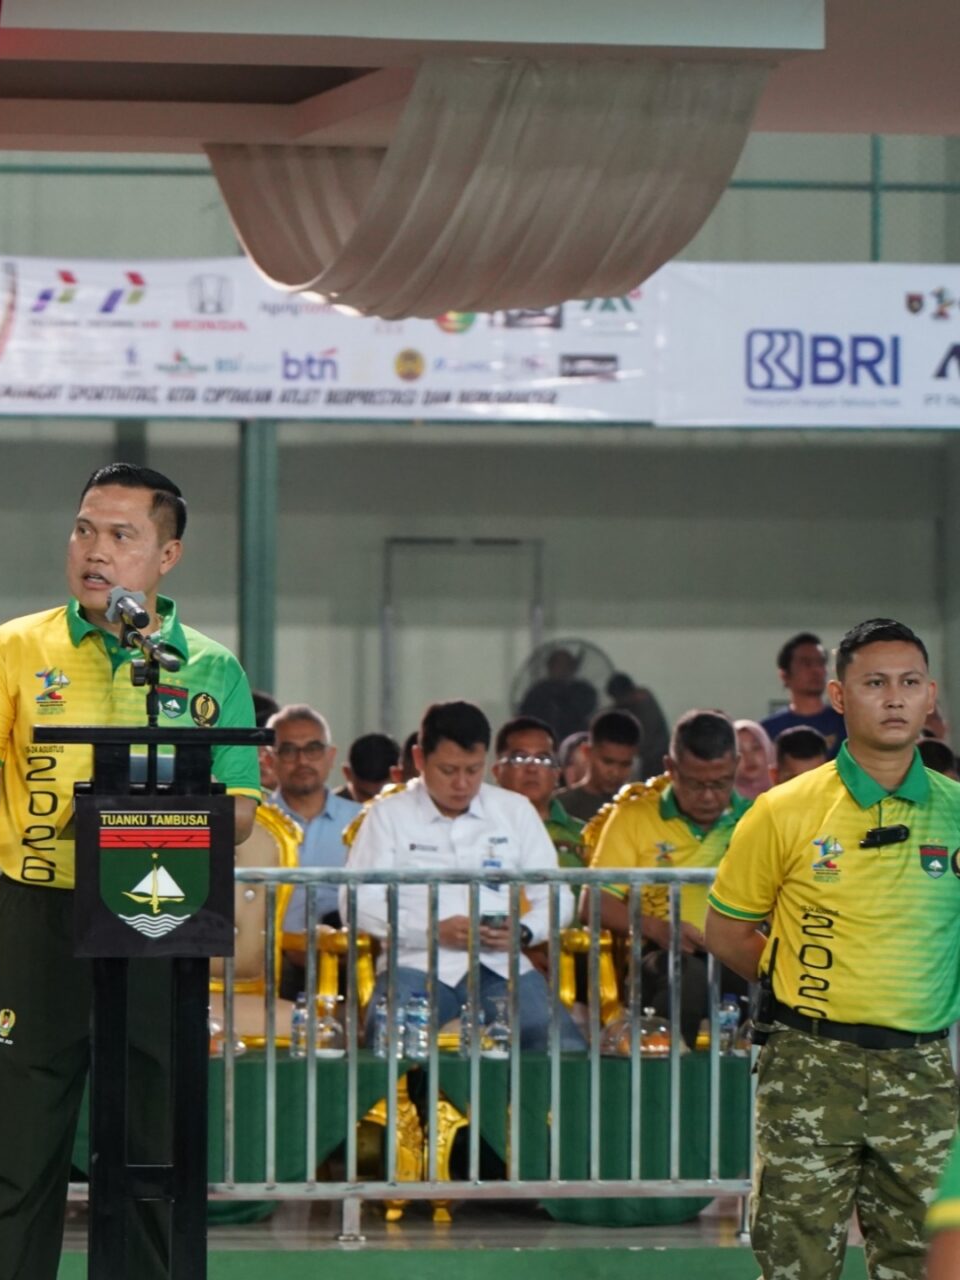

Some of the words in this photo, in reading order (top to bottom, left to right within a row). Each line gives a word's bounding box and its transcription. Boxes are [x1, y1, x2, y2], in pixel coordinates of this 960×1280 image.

[282, 352, 338, 381] btn
[809, 335, 901, 387] BRI
[21, 756, 58, 884] 2026
[100, 814, 147, 825] TUANKU
[149, 814, 208, 825] TAMBUSAI
